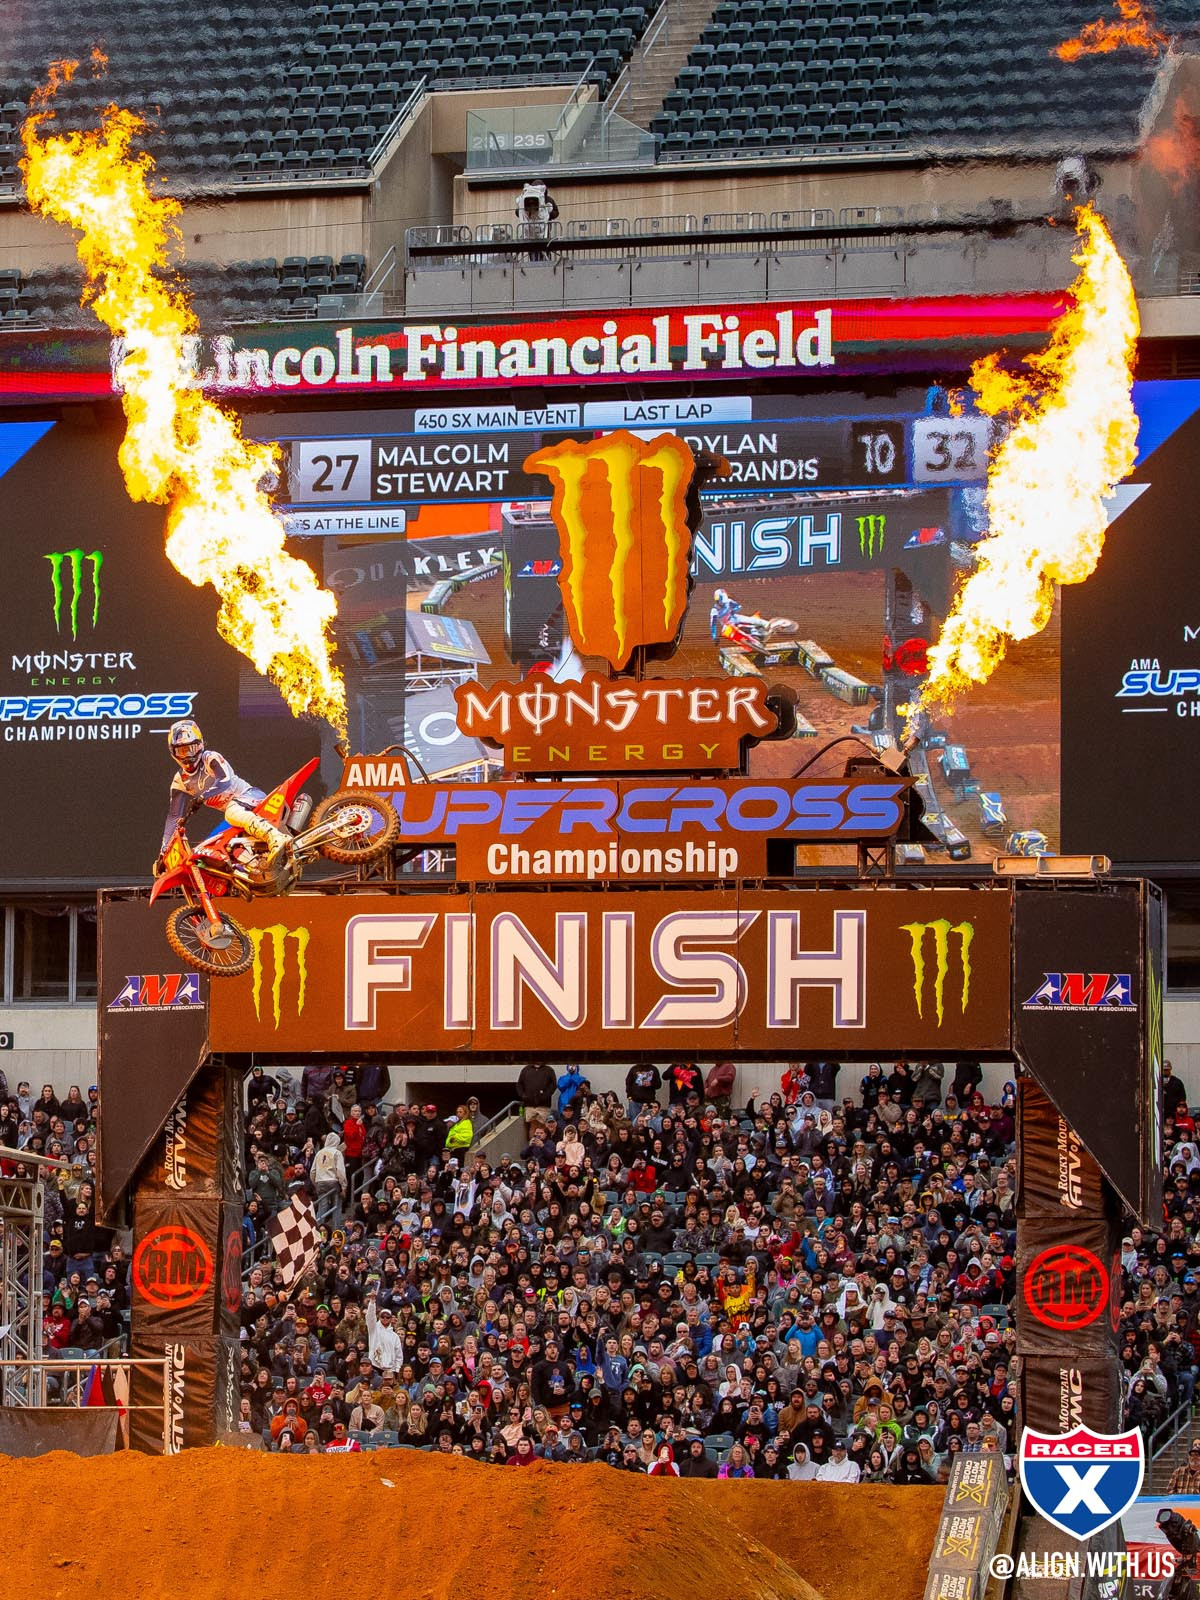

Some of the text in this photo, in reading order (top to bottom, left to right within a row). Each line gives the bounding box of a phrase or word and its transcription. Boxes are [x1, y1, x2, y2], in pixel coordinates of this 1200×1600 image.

[513, 134, 546, 148] 235
[182, 309, 836, 391] Lincoln Financial Field
[418, 409, 577, 428] 450 SX MAIN EVENT
[623, 404, 712, 420] LAST LAP
[377, 443, 509, 467] MALCOLM
[857, 432, 896, 475] 10
[926, 430, 977, 472] 32
[311, 454, 359, 492] 27
[376, 470, 509, 494] STEWART
[314, 518, 332, 530] AT
[336, 518, 370, 529] THE
[375, 516, 400, 528] LINE
[690, 512, 842, 576] NISH
[12, 650, 137, 674] MONSTER
[1130, 658, 1160, 670] AMA
[31, 676, 117, 686] ENERGY
[463, 681, 770, 736] MONSTER
[4, 724, 142, 742] CHAMPIONSHIP
[512, 742, 721, 763] ENERGY
[346, 762, 407, 787] AMA
[487, 841, 739, 879] Championship
[344, 910, 867, 1031] FINISH
[106, 972, 205, 1007] AMA
[1021, 972, 1138, 1006] AMA
[164, 1136, 175, 1173] ROCKY
[1058, 1154, 1068, 1192] ROCKY
[147, 1250, 202, 1285] RM
[1059, 1368, 1069, 1430] MOUNTAIN
